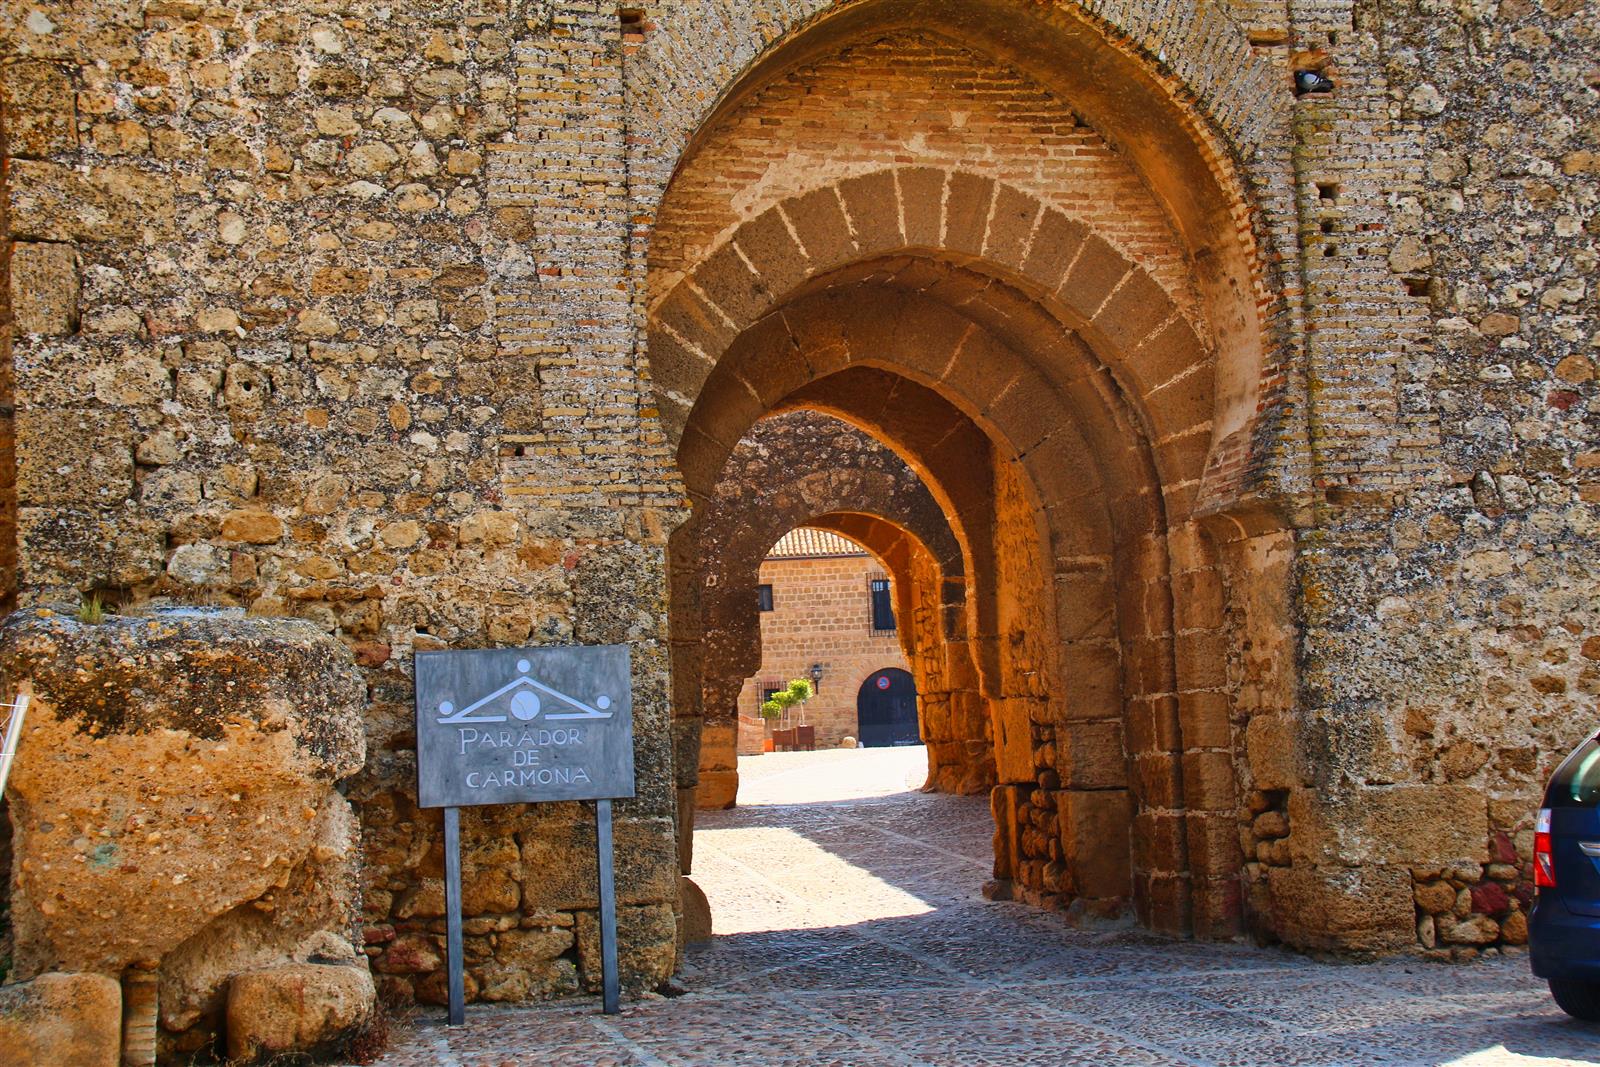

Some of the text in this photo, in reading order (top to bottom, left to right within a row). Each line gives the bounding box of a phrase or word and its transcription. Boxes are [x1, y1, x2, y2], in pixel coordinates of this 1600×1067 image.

[459, 728, 583, 755] PARADOR
[513, 749, 540, 767] DE
[466, 767, 591, 788] CARMONA
